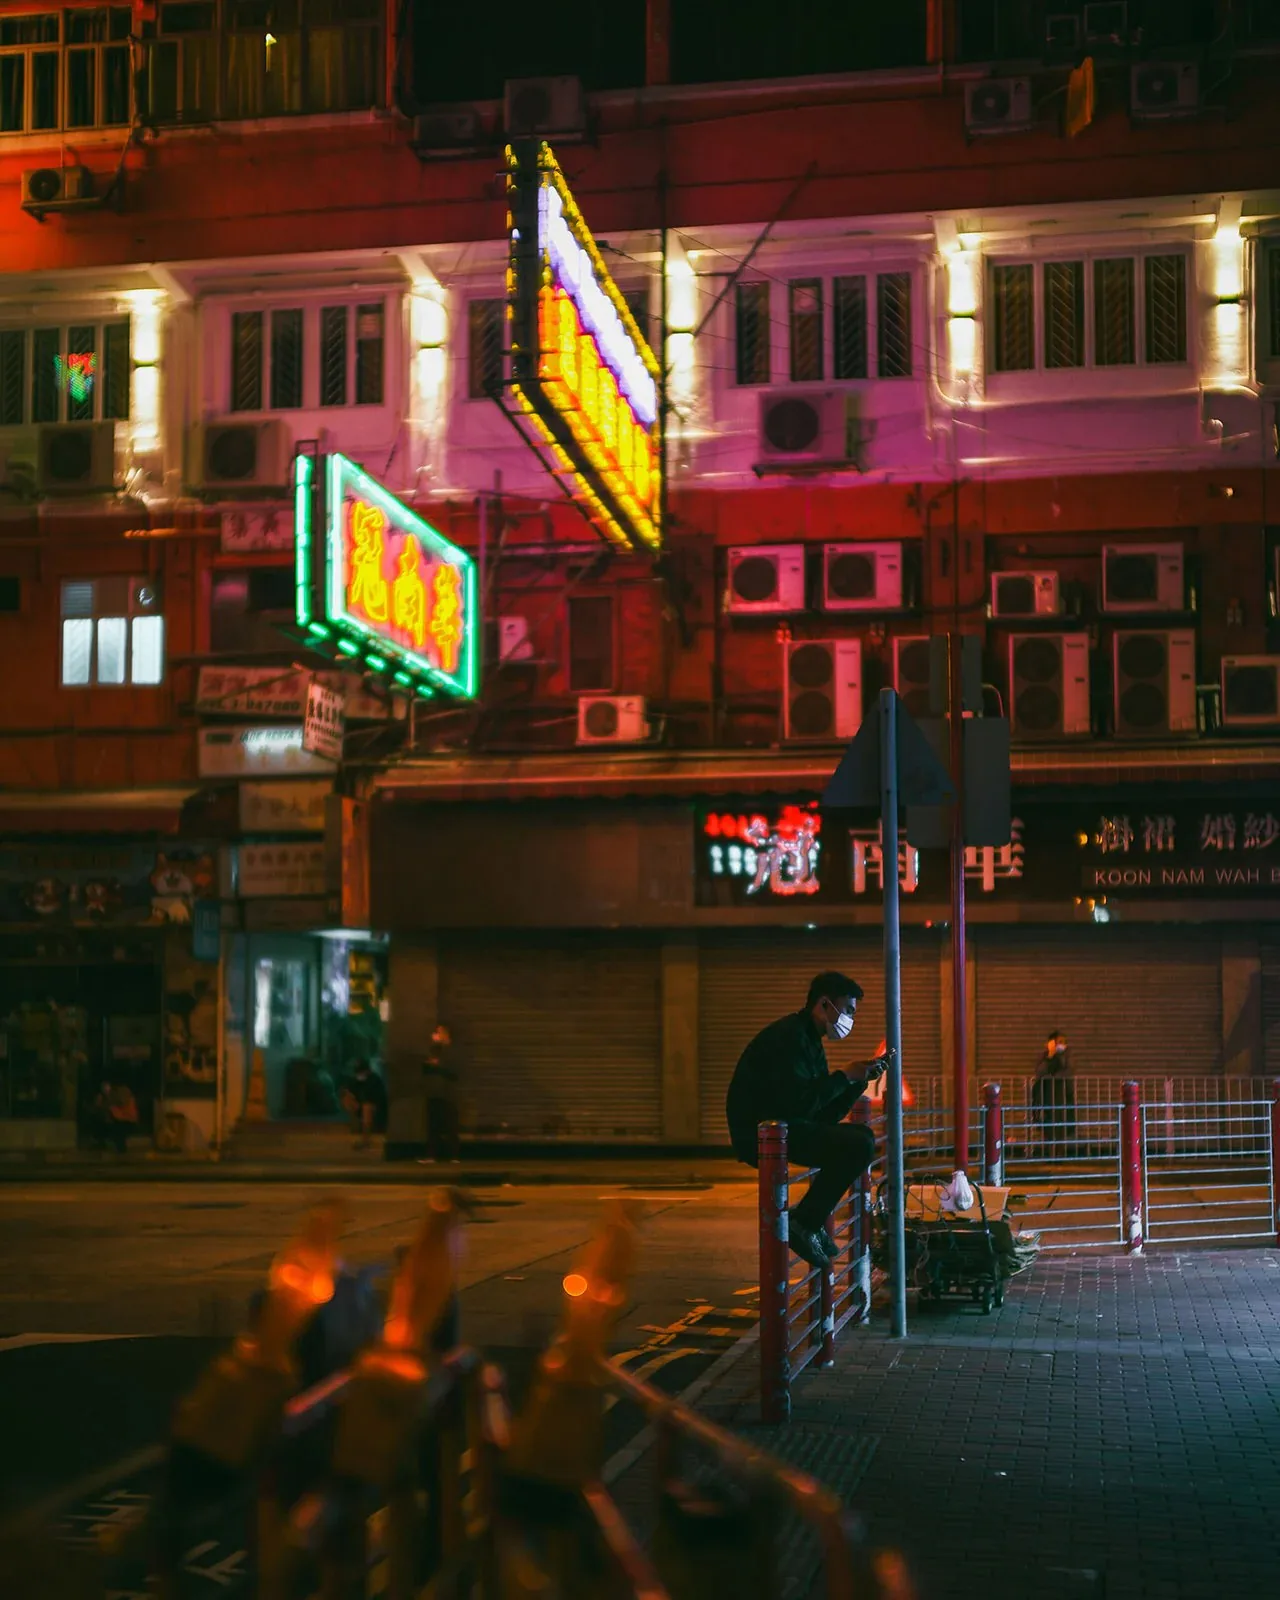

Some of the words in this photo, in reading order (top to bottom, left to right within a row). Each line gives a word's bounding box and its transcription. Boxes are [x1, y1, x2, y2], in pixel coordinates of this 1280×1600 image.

[1094, 868, 1151, 885] KOON
[1162, 867, 1205, 884] NAM
[1215, 867, 1260, 884] WAH
